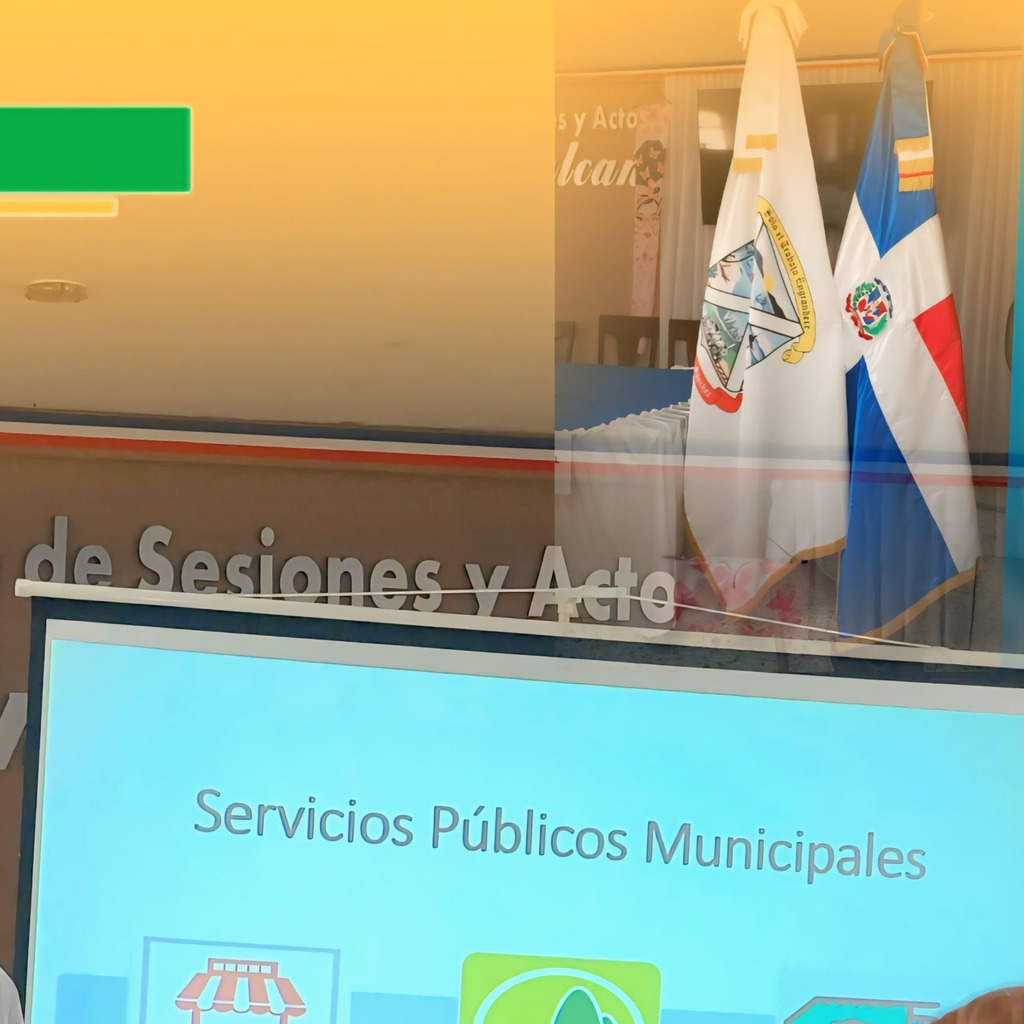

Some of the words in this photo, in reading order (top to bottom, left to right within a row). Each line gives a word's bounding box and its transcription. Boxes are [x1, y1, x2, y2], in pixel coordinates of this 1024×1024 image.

[573, 112, 587, 137] y
[23, 516, 113, 588] de
[137, 525, 442, 613] Sesiones
[465, 561, 510, 614] y
[193, 788, 415, 847] Servicios
[432, 804, 630, 862] Públicos
[646, 821, 928, 886] Municipales
